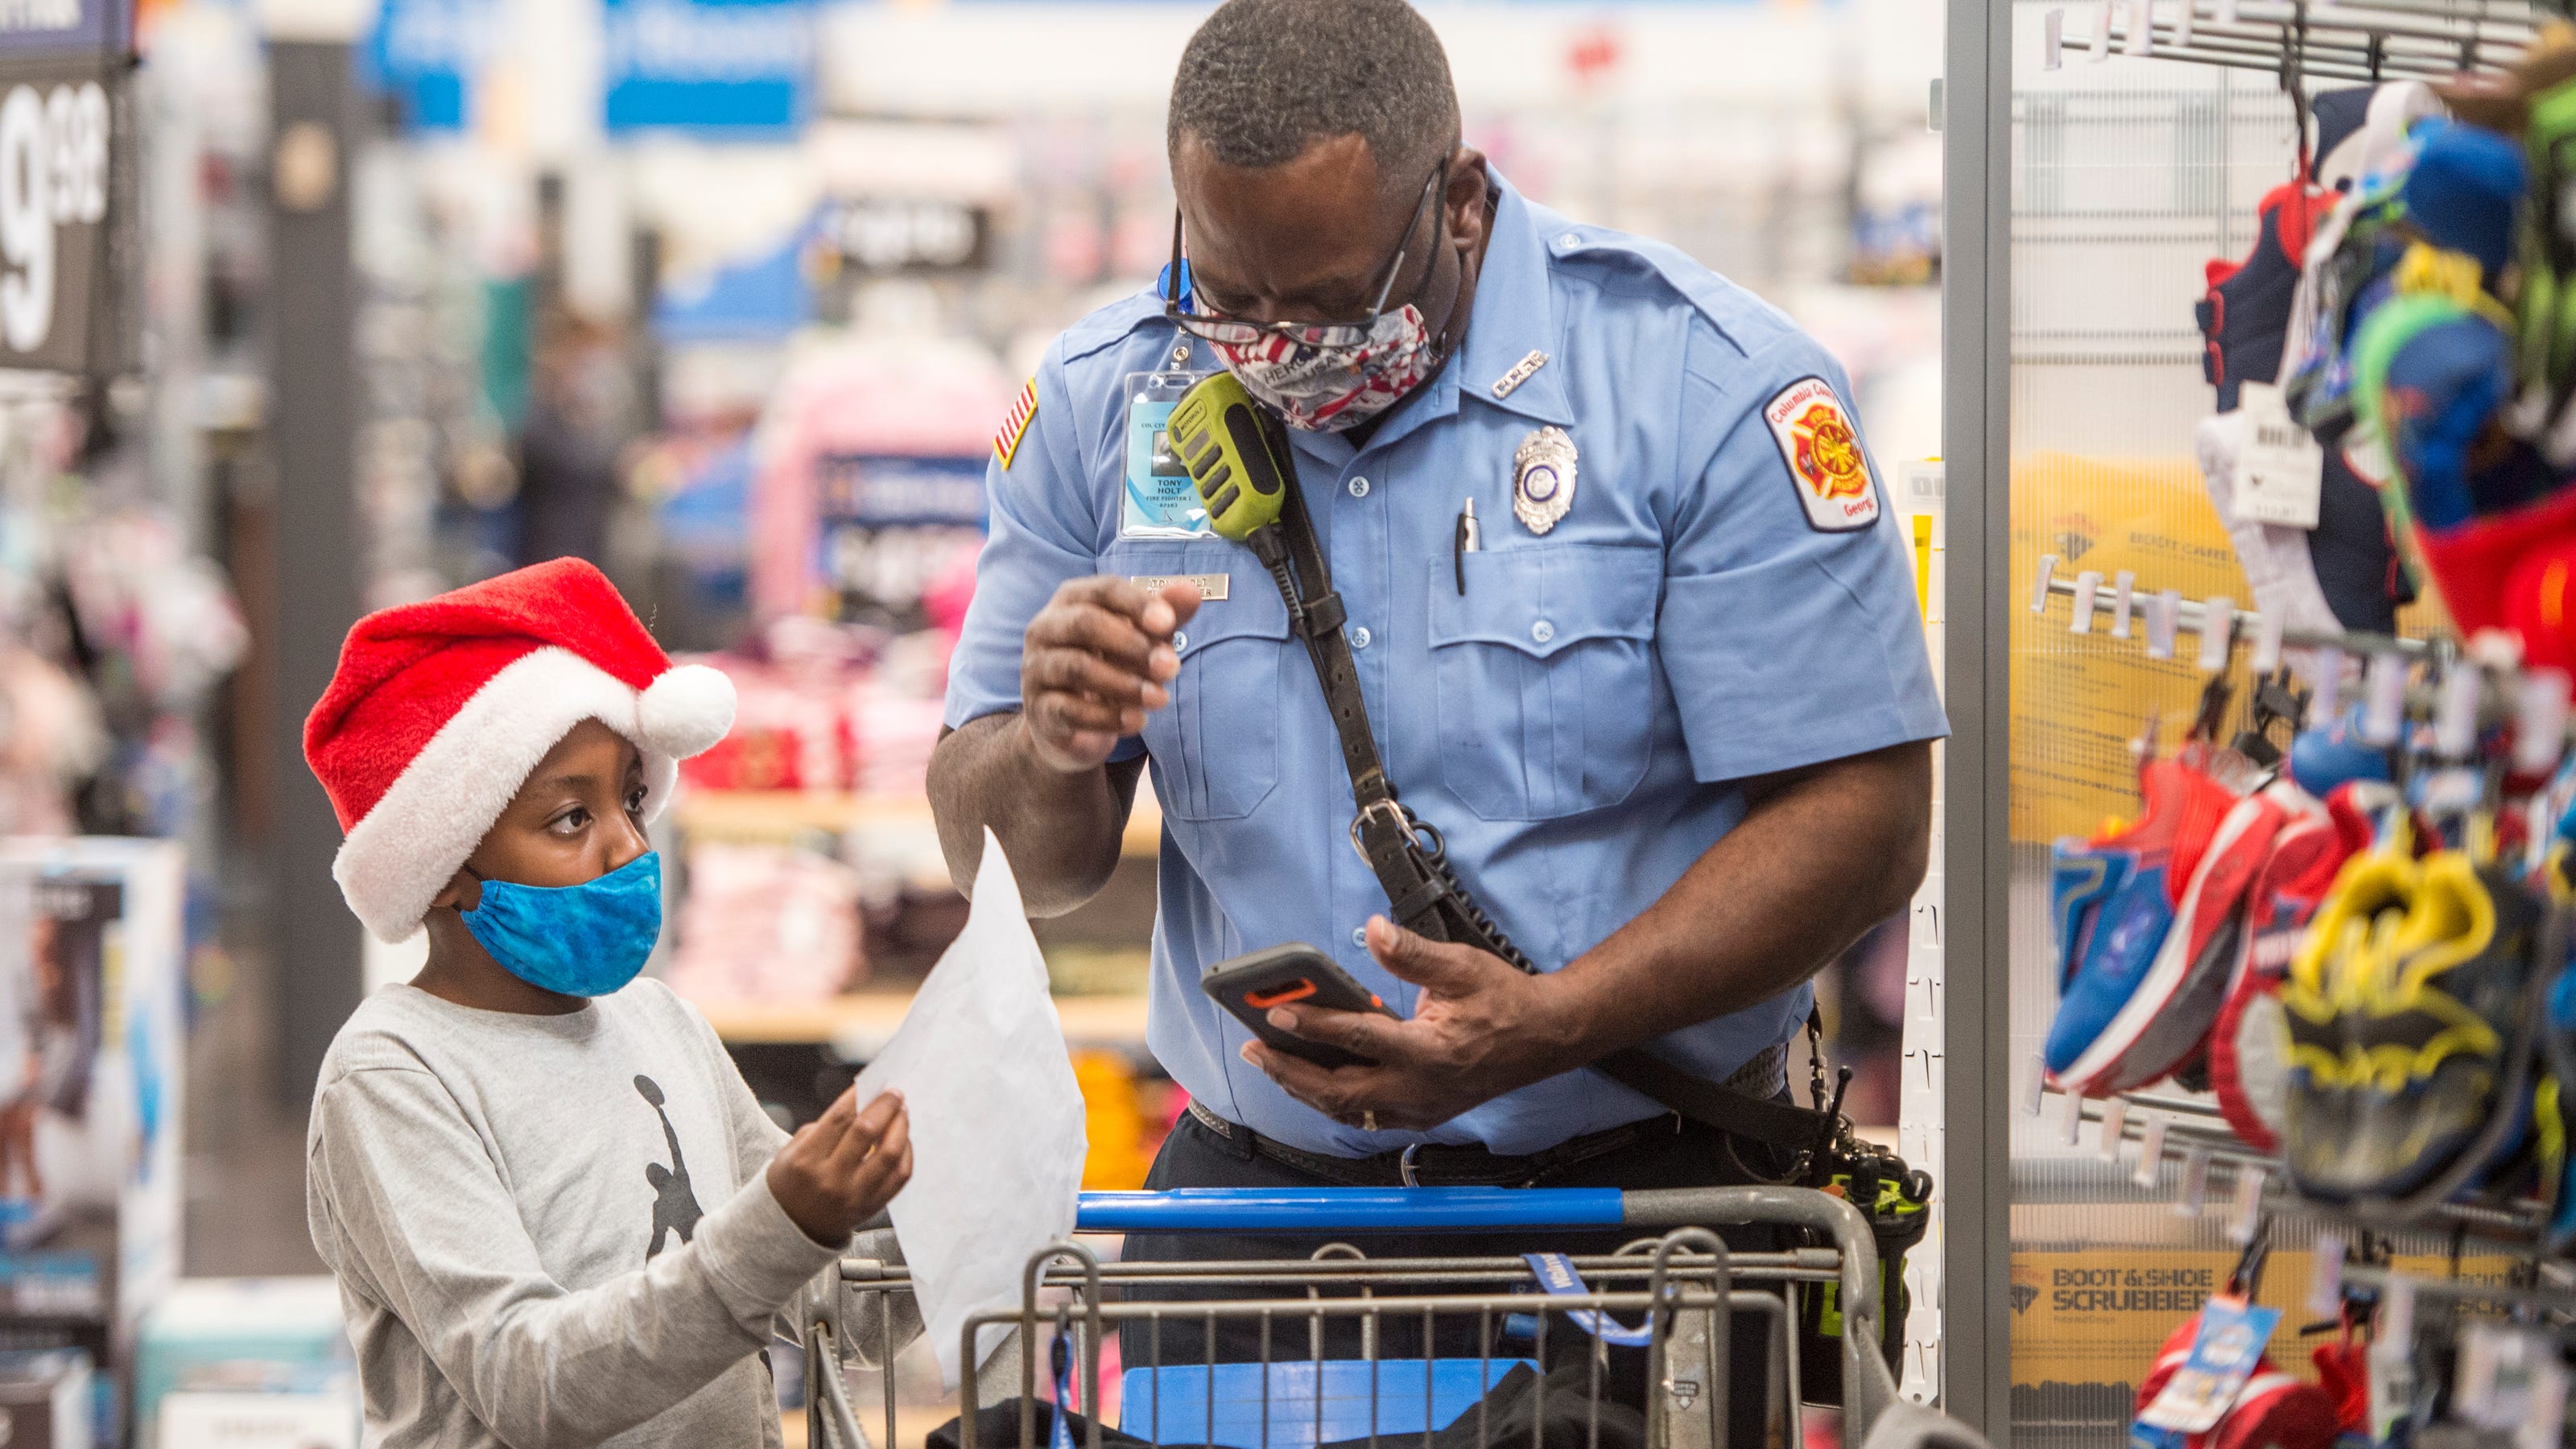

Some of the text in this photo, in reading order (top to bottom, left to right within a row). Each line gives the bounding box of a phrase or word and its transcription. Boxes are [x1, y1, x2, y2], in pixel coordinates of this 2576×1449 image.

[1771, 386, 1813, 423] Columbia
[1810, 408, 1831, 424] FIRE
[2054, 1268, 2214, 1286] BOOT & SHOE
[2054, 1290, 2212, 1311] SCRUBBER
